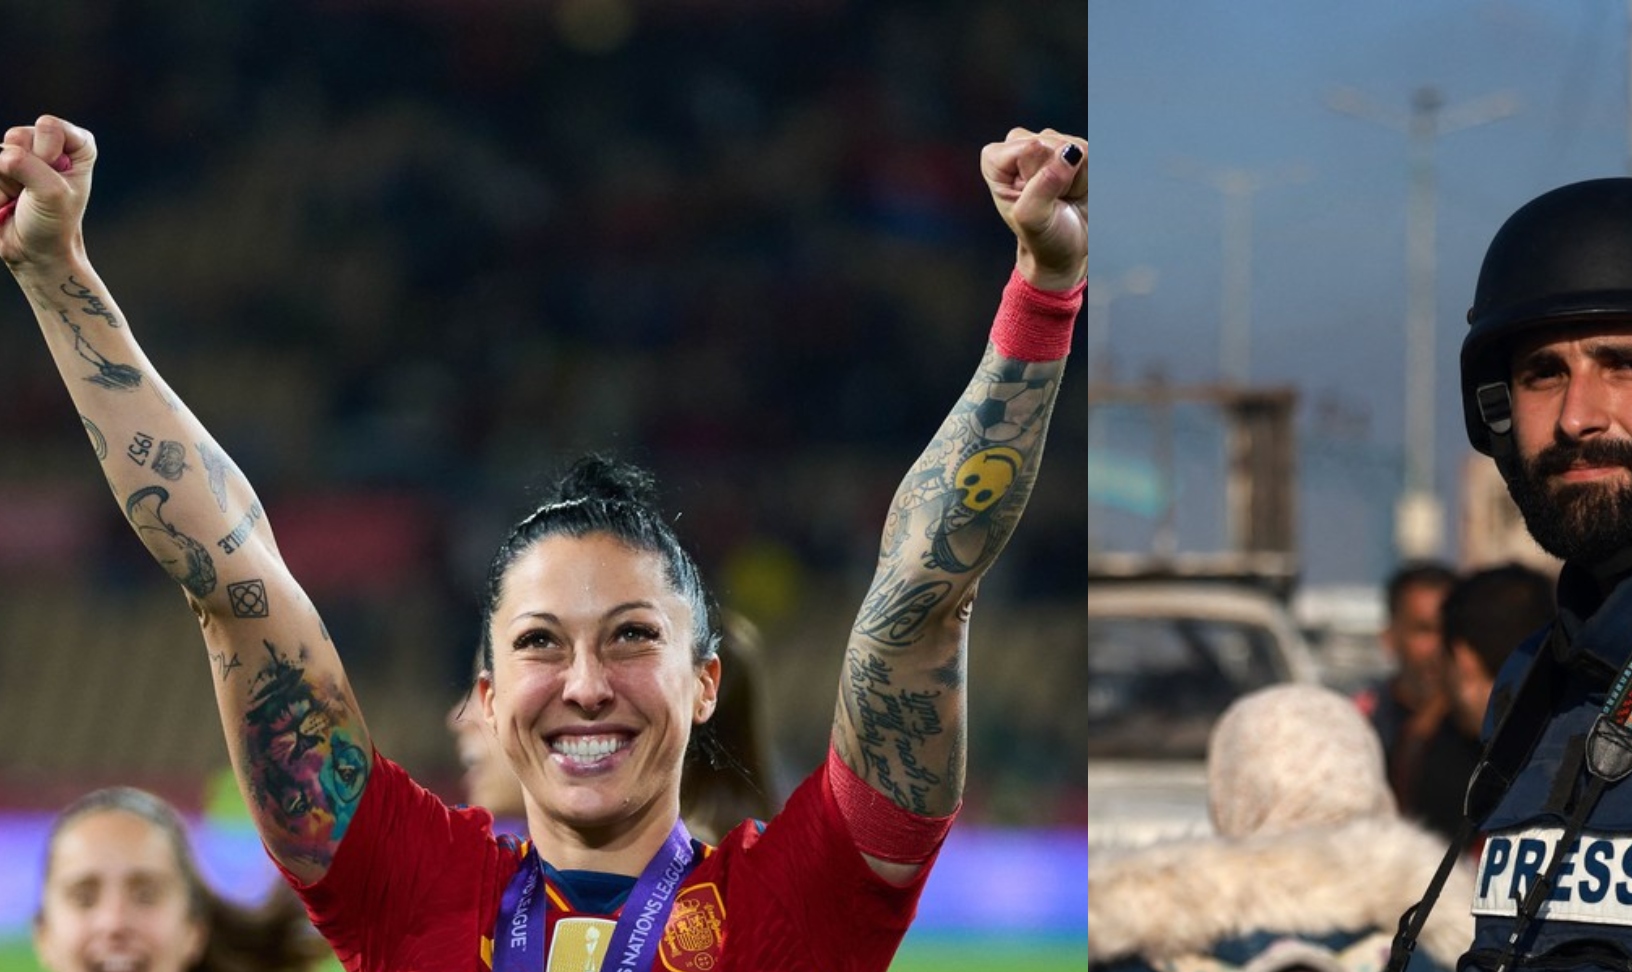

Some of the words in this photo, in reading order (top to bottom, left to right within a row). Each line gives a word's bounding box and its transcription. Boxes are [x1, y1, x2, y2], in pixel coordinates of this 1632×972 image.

[127, 431, 155, 467] 1957
[624, 899, 663, 966] NATIONS
[652, 845, 688, 901] LEAGUE
